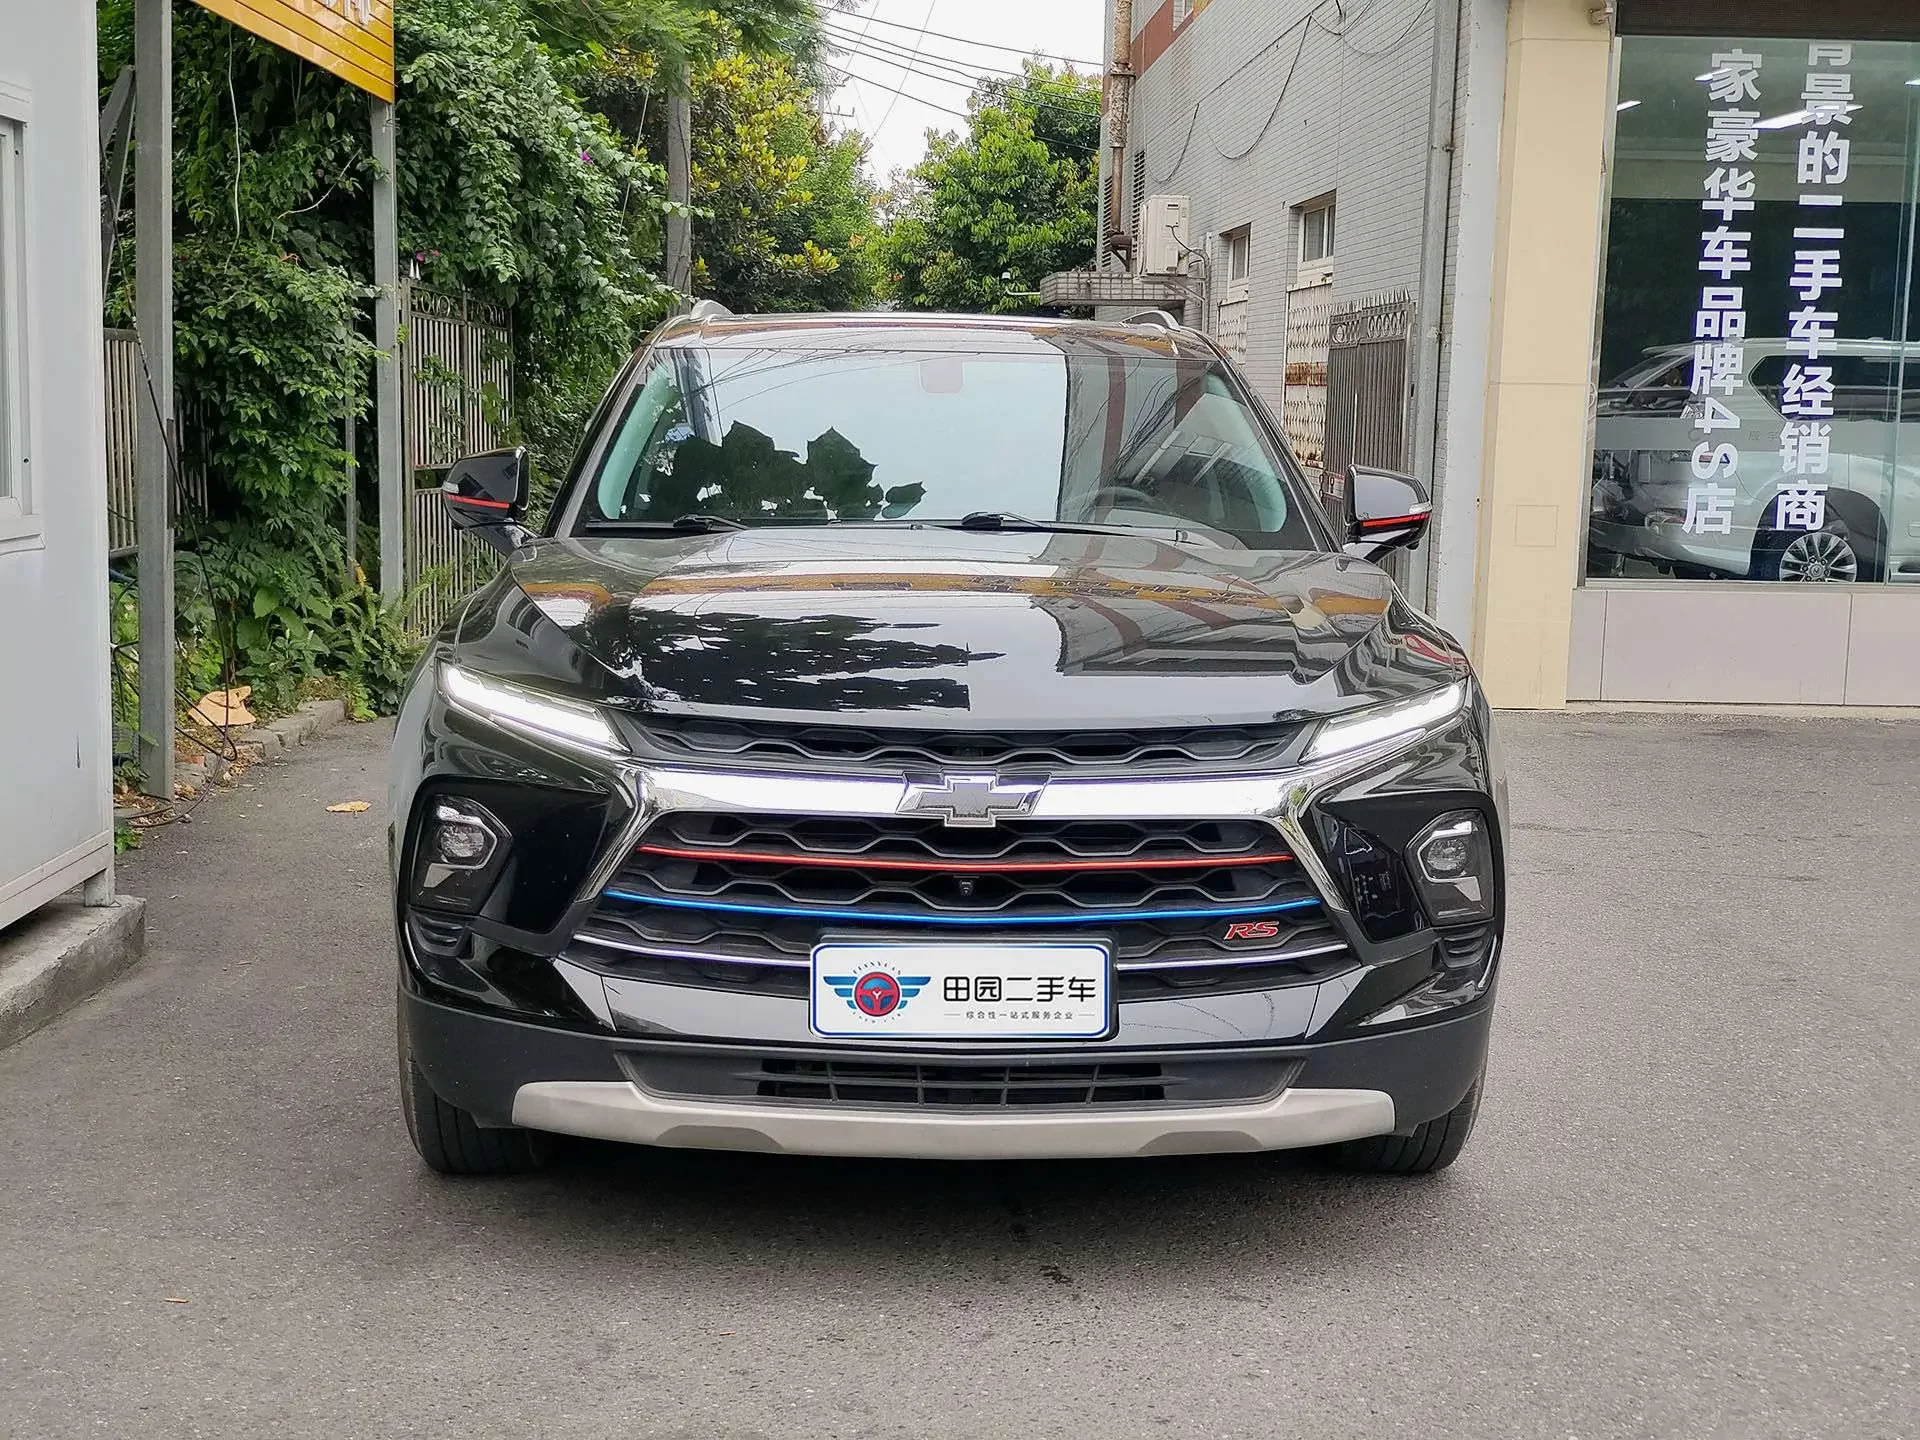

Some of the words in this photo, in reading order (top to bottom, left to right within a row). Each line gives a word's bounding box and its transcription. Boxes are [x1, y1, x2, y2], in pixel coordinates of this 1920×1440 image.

[1681, 47, 1763, 535] 家豪华车品牌4S店
[1223, 920, 1280, 940] RS
[943, 976, 1096, 1002] 田园二手车
[965, 1011, 1073, 1020] 综合性一站式服务企业
